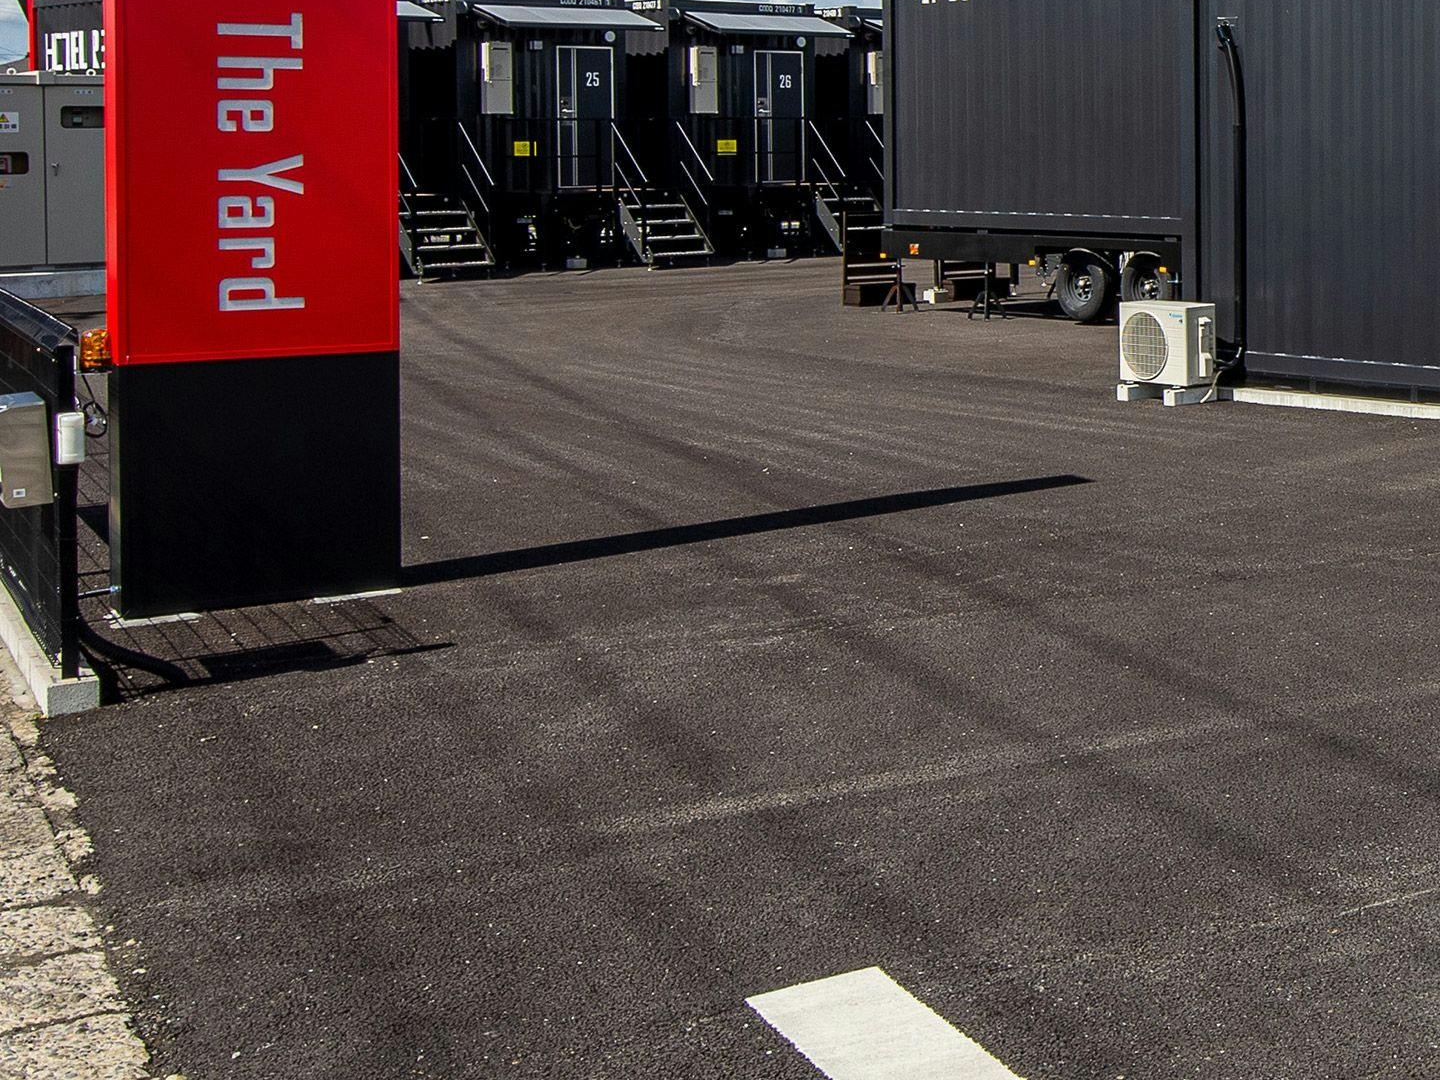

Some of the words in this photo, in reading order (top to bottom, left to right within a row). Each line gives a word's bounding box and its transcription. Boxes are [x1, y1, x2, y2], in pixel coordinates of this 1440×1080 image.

[217, 12, 304, 133] The
[586, 71, 600, 88] 25
[779, 74, 792, 89] 26
[218, 153, 306, 313] Yard
